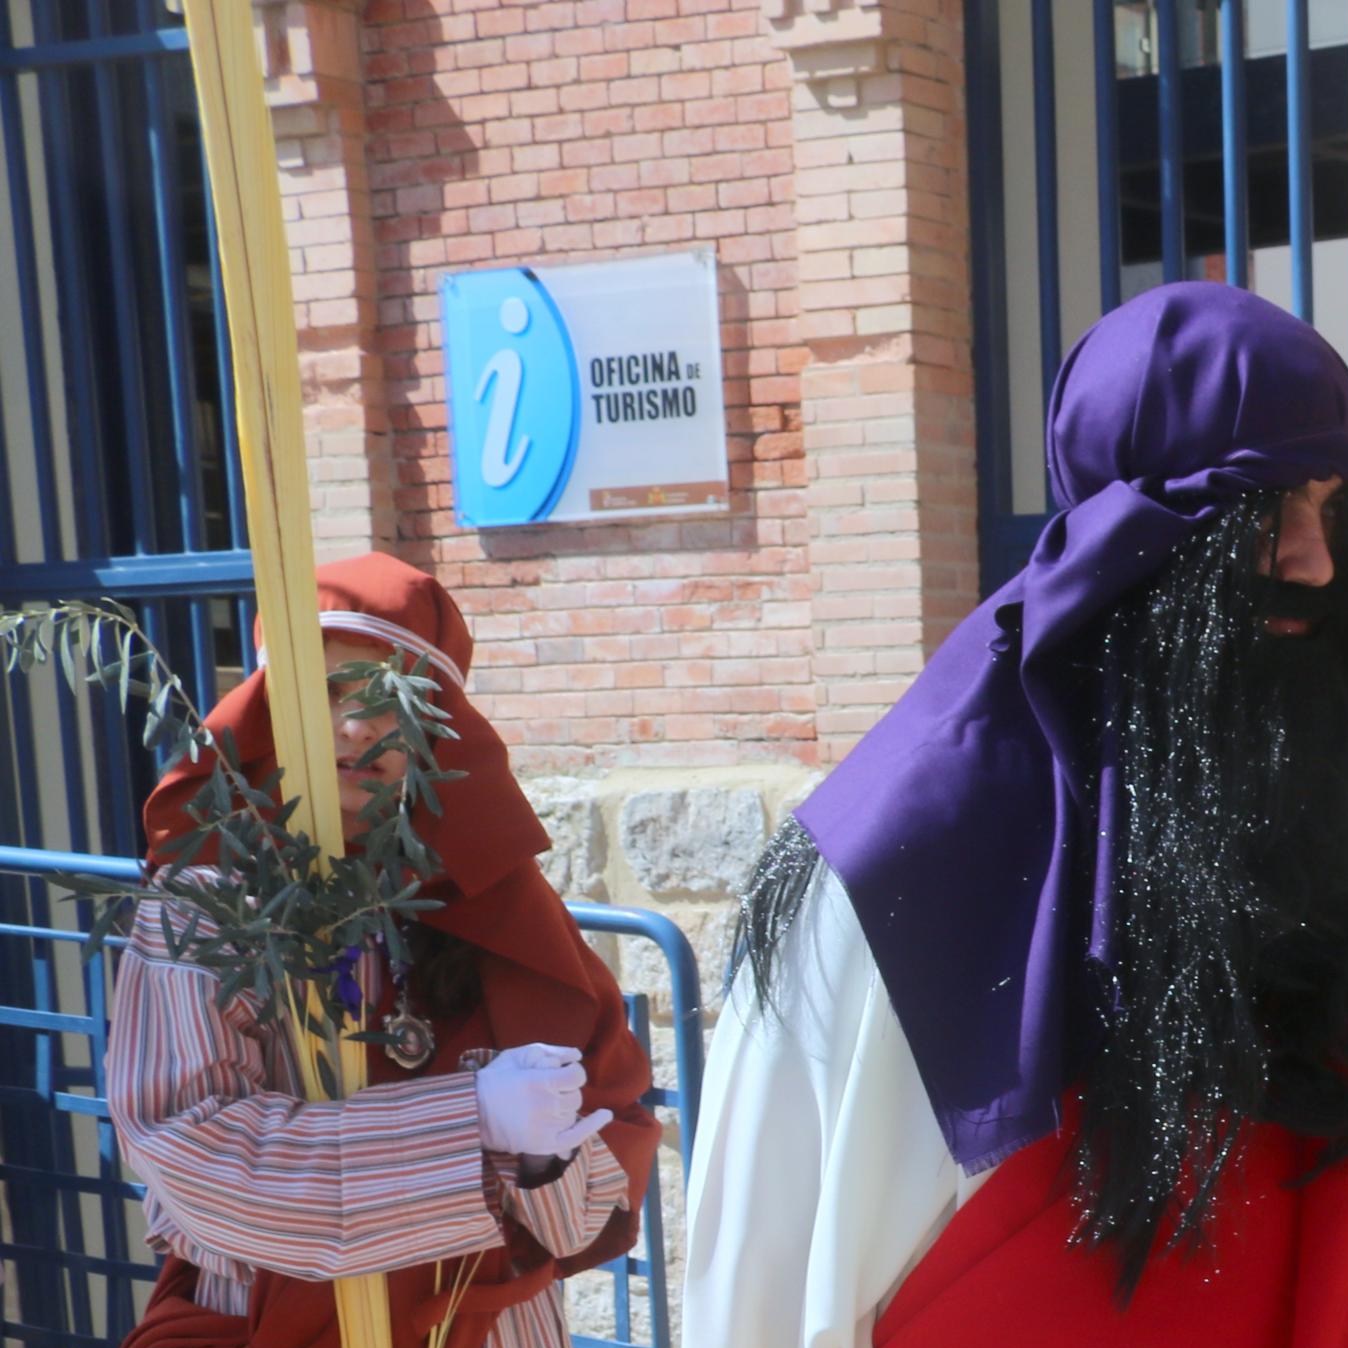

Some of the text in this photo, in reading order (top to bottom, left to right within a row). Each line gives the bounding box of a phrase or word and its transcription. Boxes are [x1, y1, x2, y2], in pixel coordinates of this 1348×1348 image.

[590, 351, 700, 387] OFICINA DE
[592, 386, 696, 423] TURISMO
